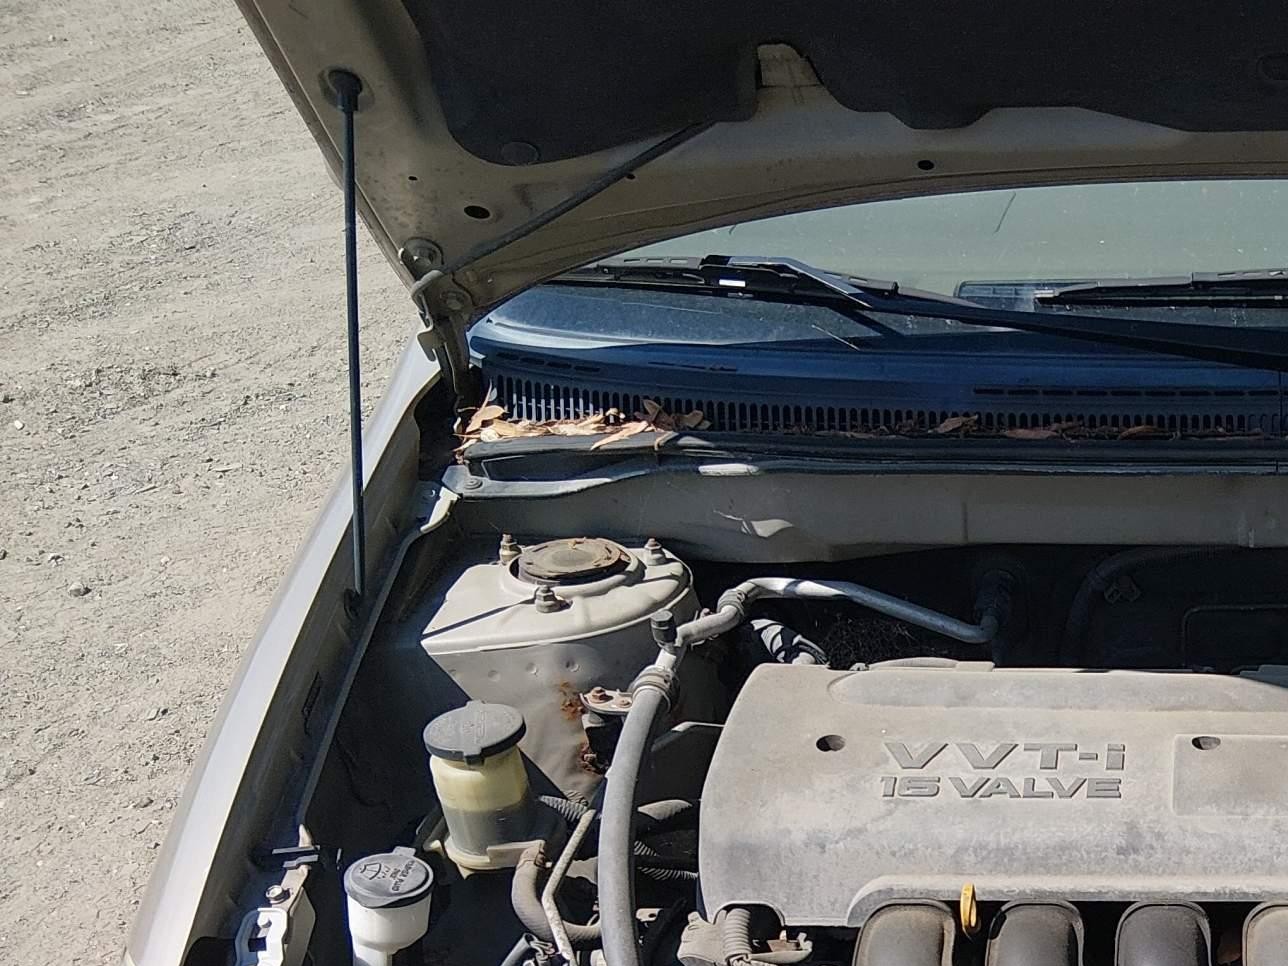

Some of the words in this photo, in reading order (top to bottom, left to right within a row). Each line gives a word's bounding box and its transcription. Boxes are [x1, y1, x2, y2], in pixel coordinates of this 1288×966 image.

[884, 743, 1125, 770] VVT-i
[880, 776, 941, 798] 16
[948, 776, 1122, 799] VALVE
